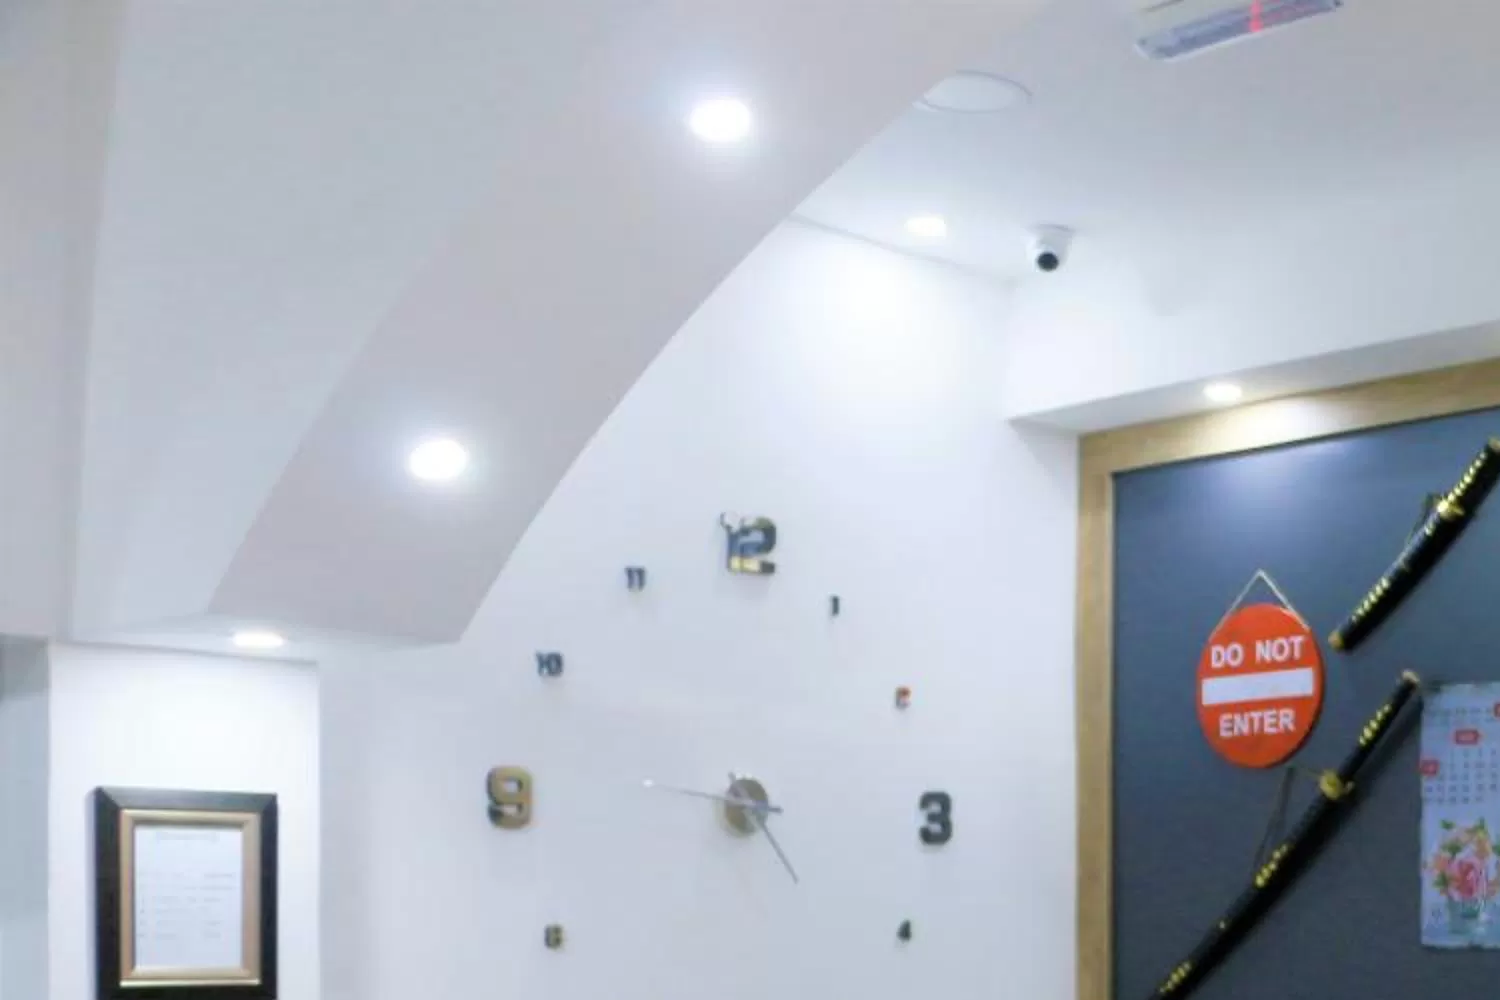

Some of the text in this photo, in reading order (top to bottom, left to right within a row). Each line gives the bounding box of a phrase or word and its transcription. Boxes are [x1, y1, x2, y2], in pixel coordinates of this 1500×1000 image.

[719, 511, 777, 575] 12
[625, 567, 646, 590] 11
[536, 652, 564, 677] 10
[1211, 635, 1304, 668] DO NOT
[1219, 708, 1295, 737] ENTER
[486, 766, 532, 829] 9
[919, 792, 952, 845] 3
[898, 921, 912, 942] 4
